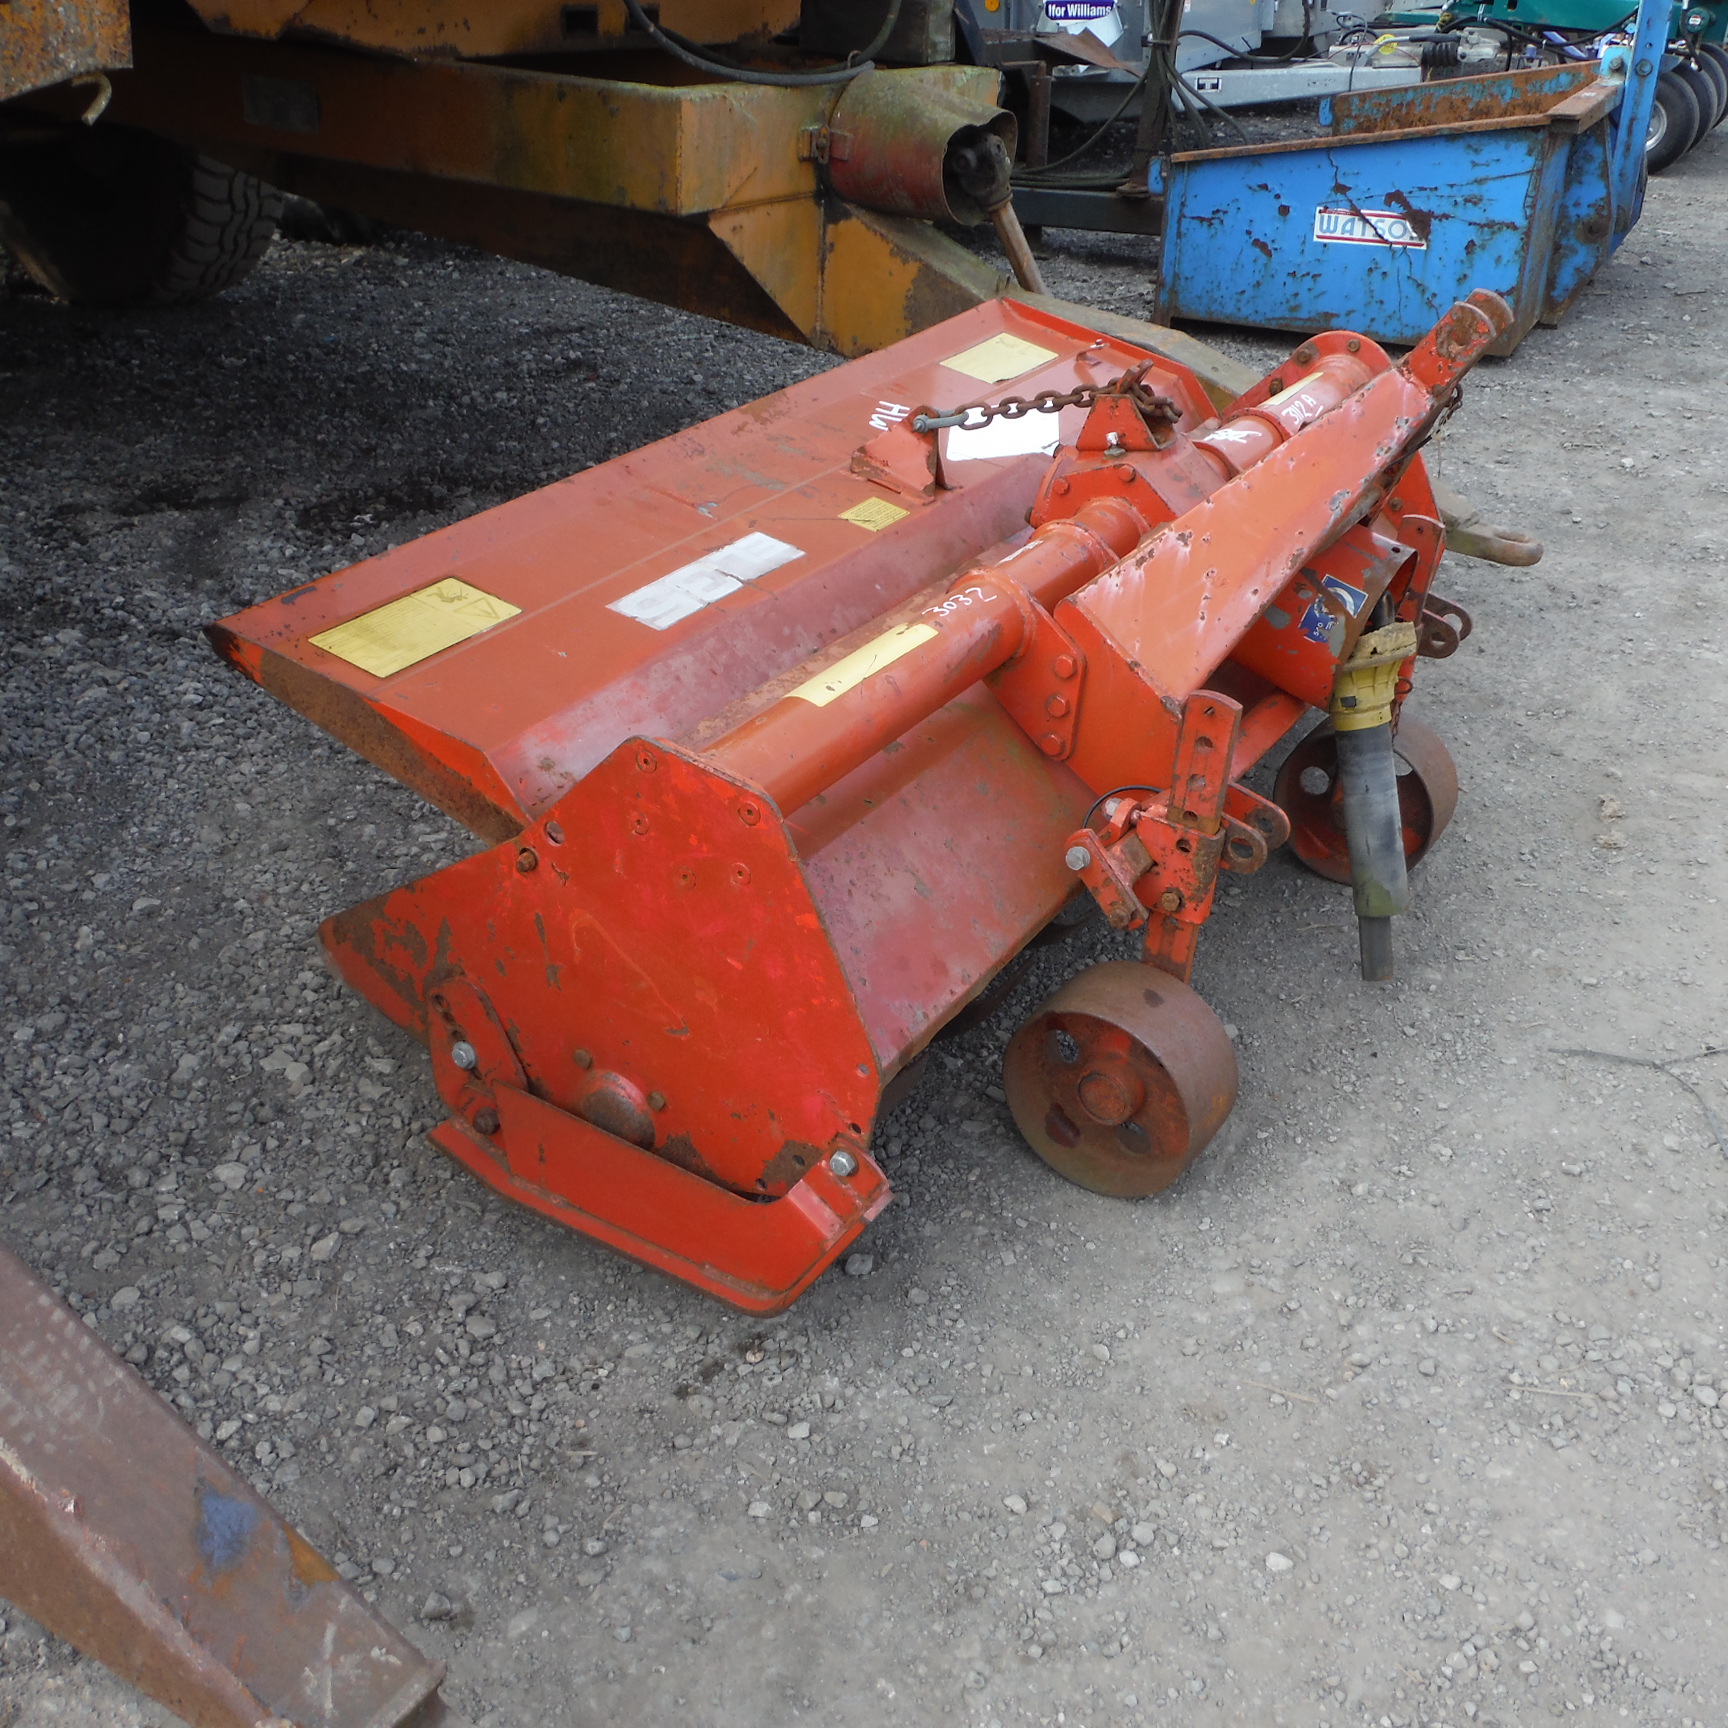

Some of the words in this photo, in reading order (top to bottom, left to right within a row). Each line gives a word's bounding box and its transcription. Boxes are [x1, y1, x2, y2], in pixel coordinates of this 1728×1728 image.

[1048, 4, 1065, 17] Ifor
[1067, 4, 1111, 17] Williams
[1319, 214, 1424, 241] WATSO
[921, 587, 998, 616] 3032
